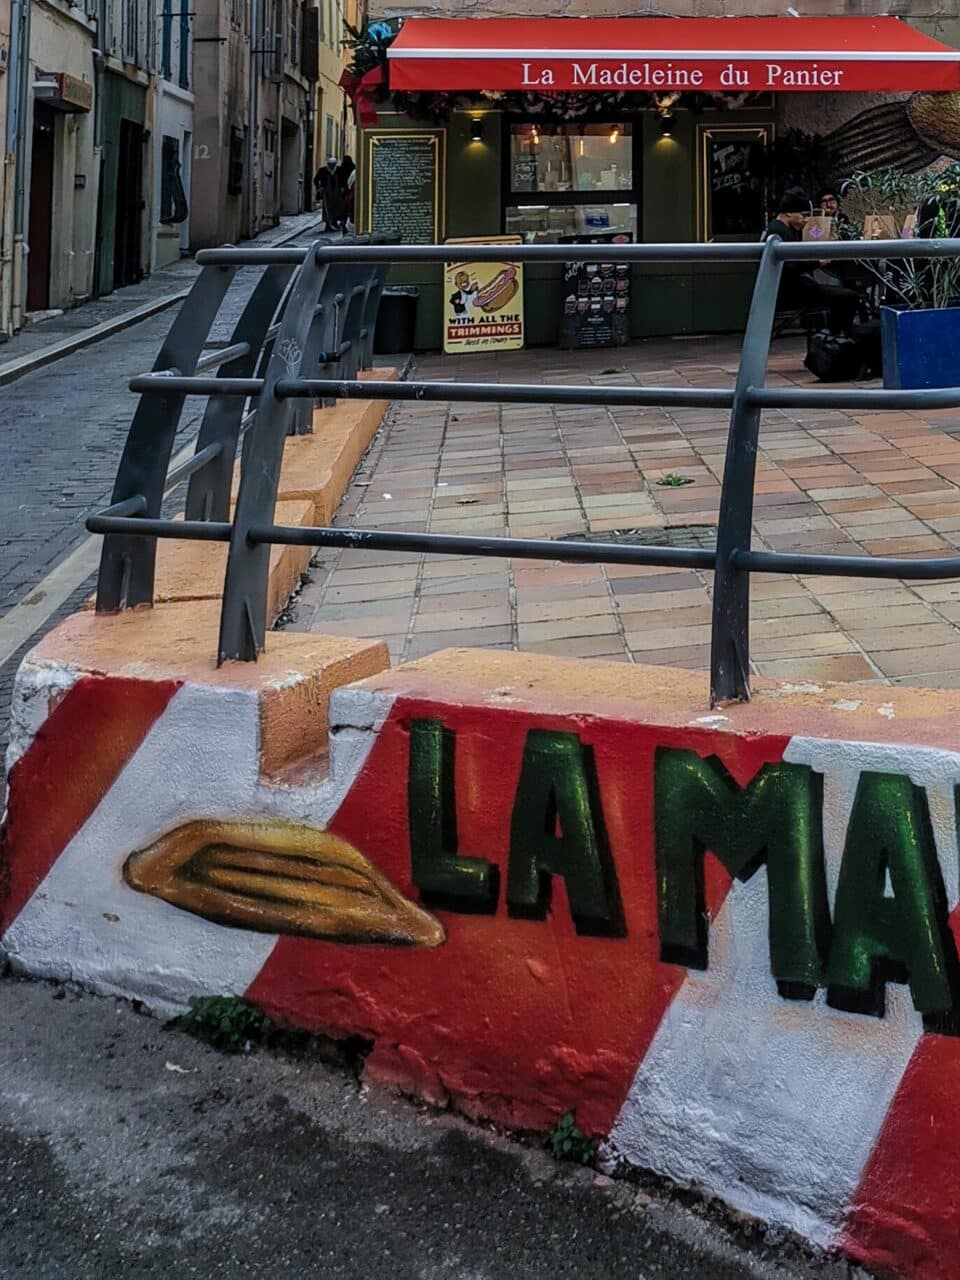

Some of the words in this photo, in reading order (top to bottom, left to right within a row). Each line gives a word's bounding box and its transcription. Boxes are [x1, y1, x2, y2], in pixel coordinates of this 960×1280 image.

[521, 62, 556, 85] La
[571, 62, 704, 86] Madeleine
[719, 63, 750, 86] du
[766, 63, 844, 86] Panier
[449, 317, 475, 325] WITH
[478, 315, 497, 323] ALL
[500, 314, 521, 322] THE
[449, 323, 520, 337] TRIMMINGS
[408, 718, 627, 938] LA
